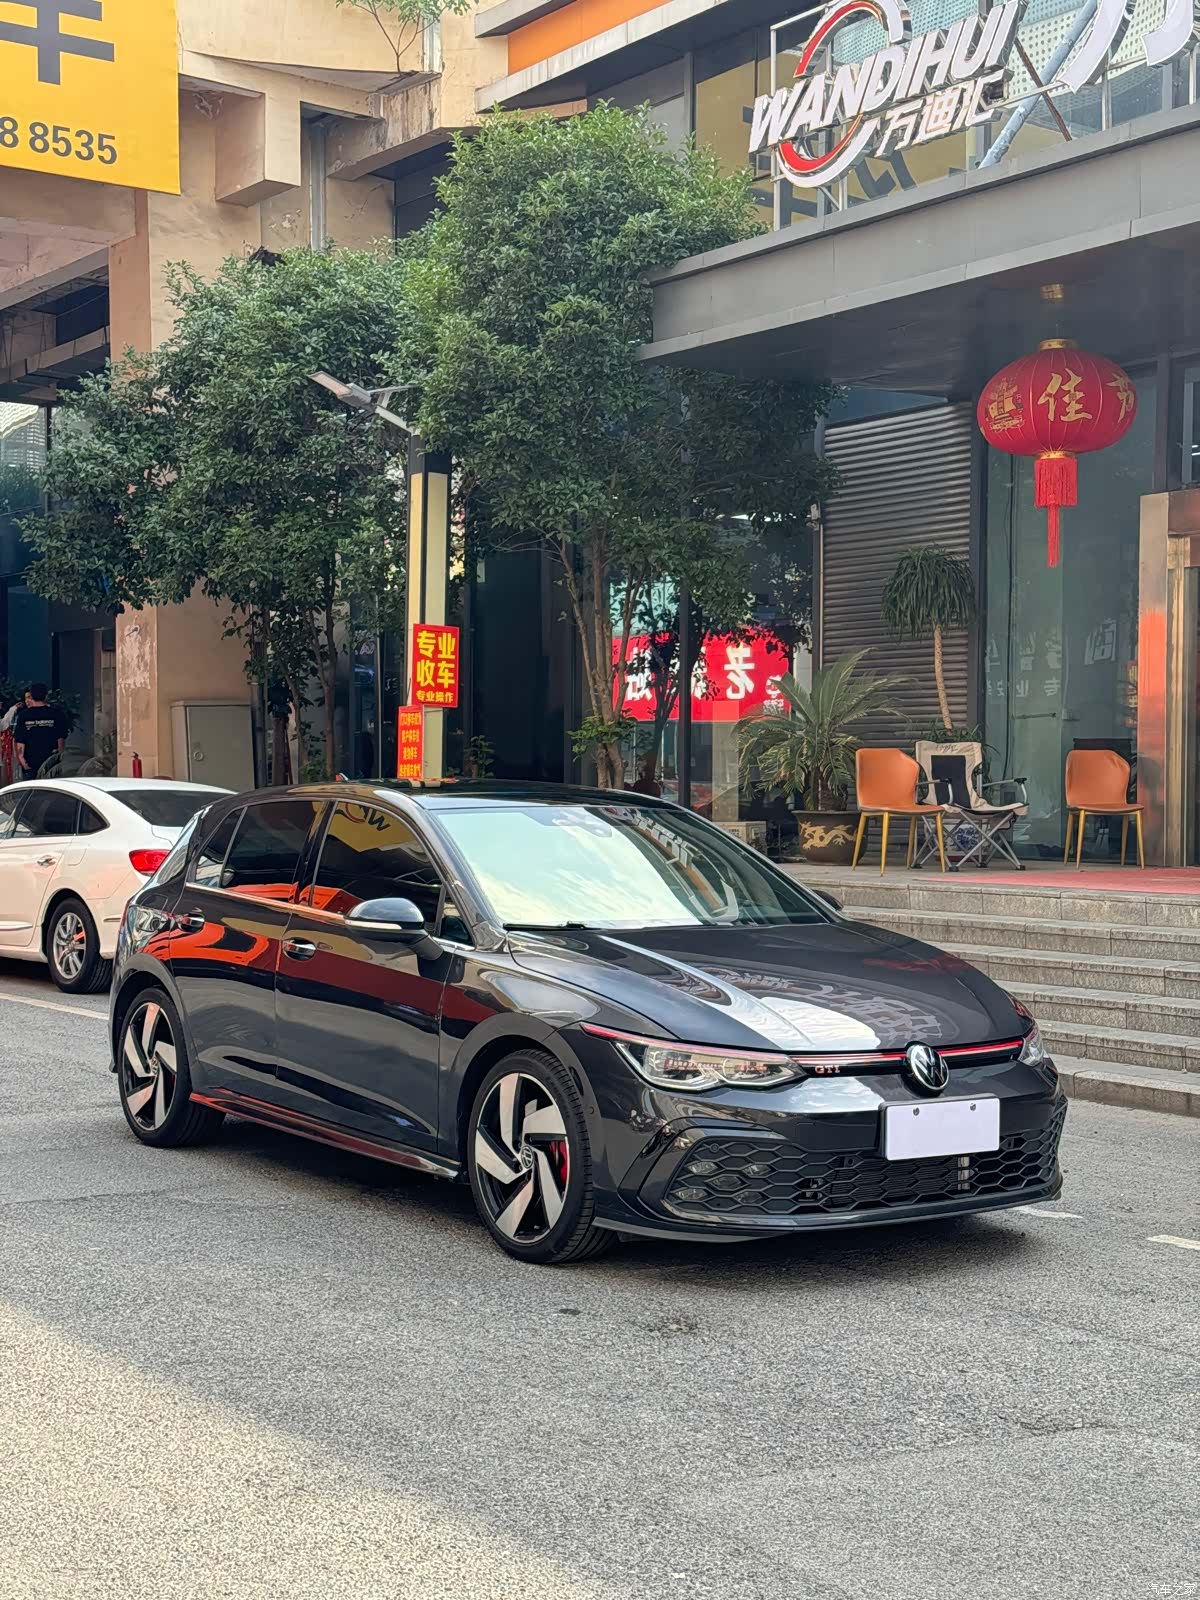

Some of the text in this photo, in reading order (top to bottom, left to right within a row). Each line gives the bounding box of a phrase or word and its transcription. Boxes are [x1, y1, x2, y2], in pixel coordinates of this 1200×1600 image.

[748, 0, 1020, 154] WANDIHUI
[876, 72, 1006, 157] 万迪汇
[29, 121, 117, 165] 8535
[416, 631, 456, 659] 专业
[416, 659, 455, 688] 收车
[416, 690, 454, 704] 专业操作
[814, 1065, 841, 1074] GTI
